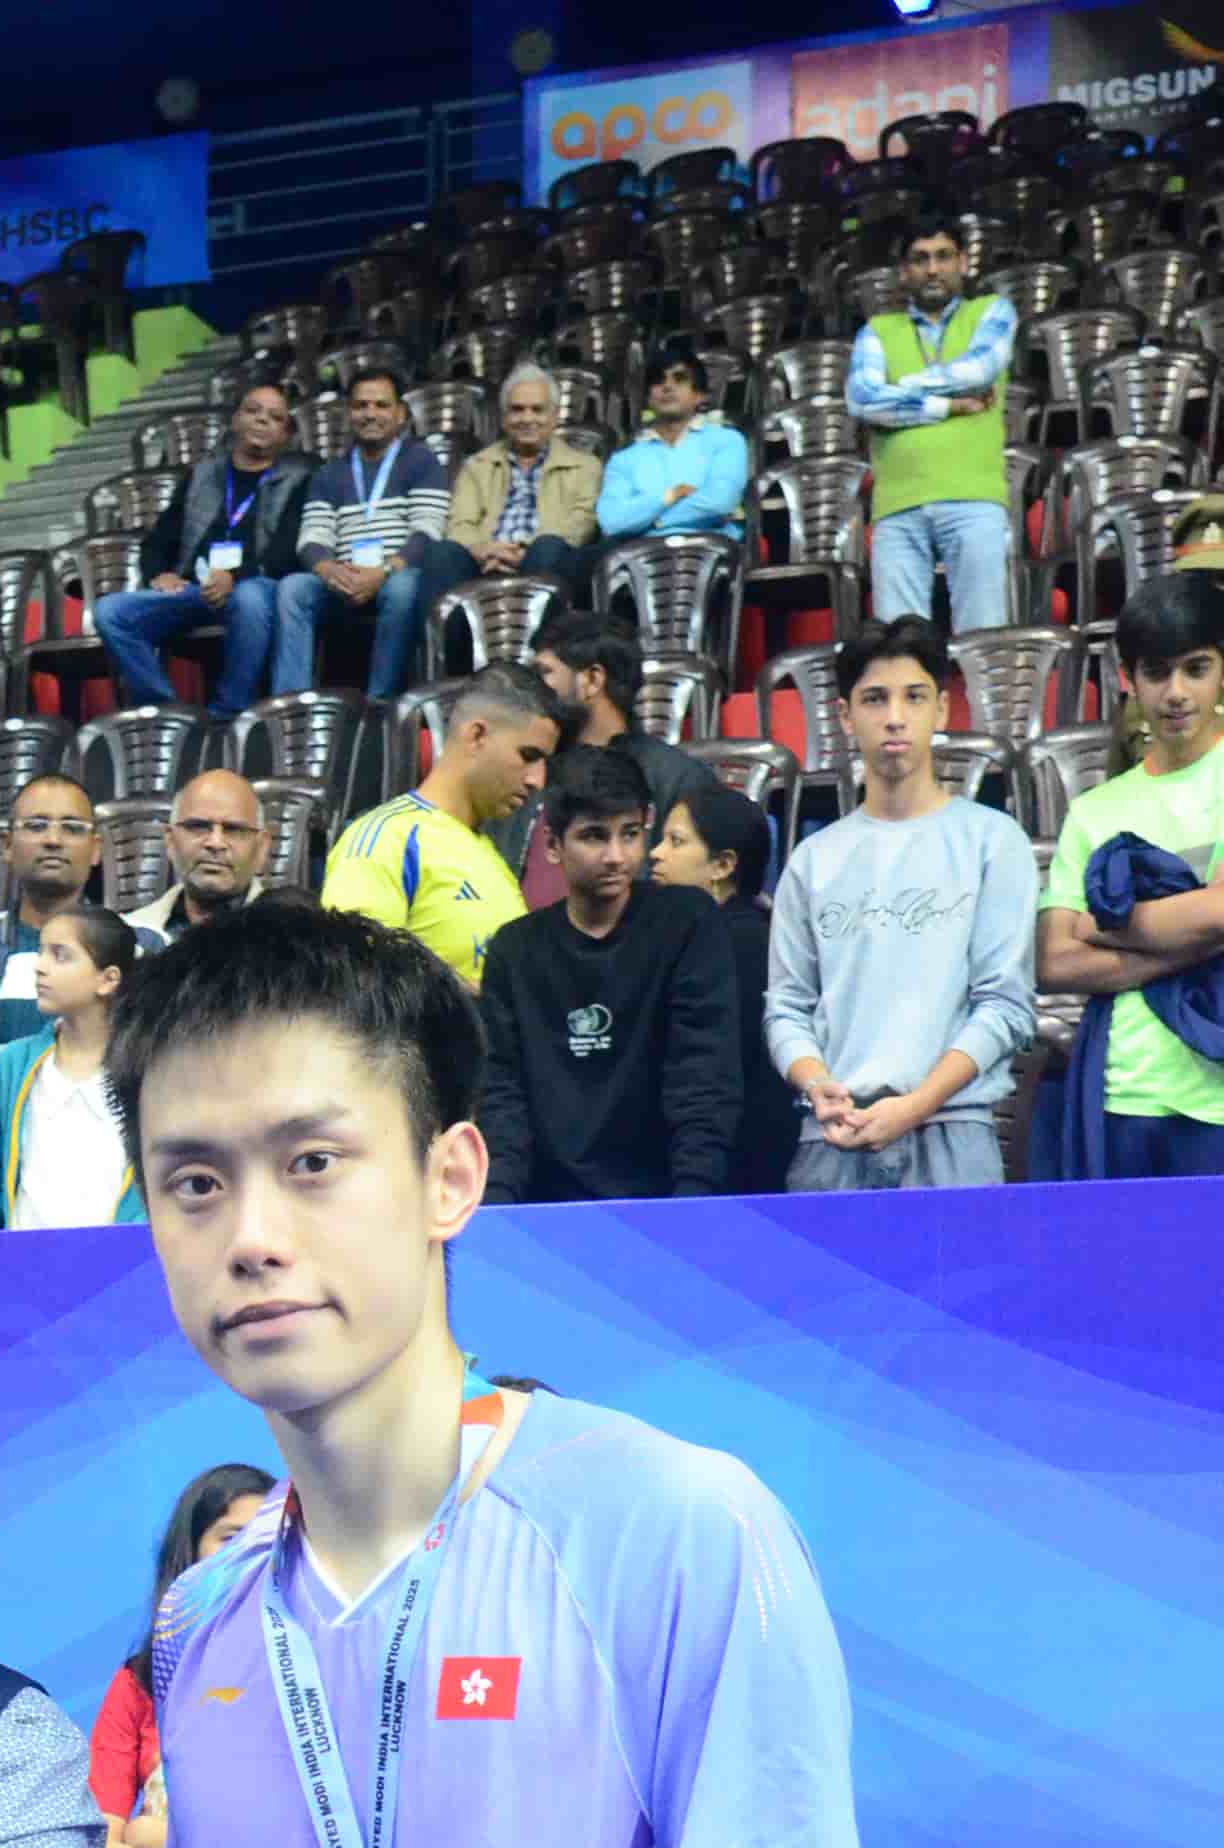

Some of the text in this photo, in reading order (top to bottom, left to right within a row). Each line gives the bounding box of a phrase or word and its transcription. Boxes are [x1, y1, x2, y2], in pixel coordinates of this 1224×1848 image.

[1056, 65, 1216, 110] MIGSUN
[550, 91, 733, 162] apco
[401, 1578, 421, 1612] 2025
[273, 1631, 310, 1737] INTERNATIONAL
[380, 1615, 410, 1728] INTERNATIONAL
[304, 1687, 332, 1755] LUCKNOW
[390, 1679, 408, 1753] LUCKNOW
[300, 1738, 321, 1780] INDIA
[377, 1731, 389, 1772] INDIA
[312, 1780, 333, 1817] MODI
[374, 1775, 385, 1813] MODI
